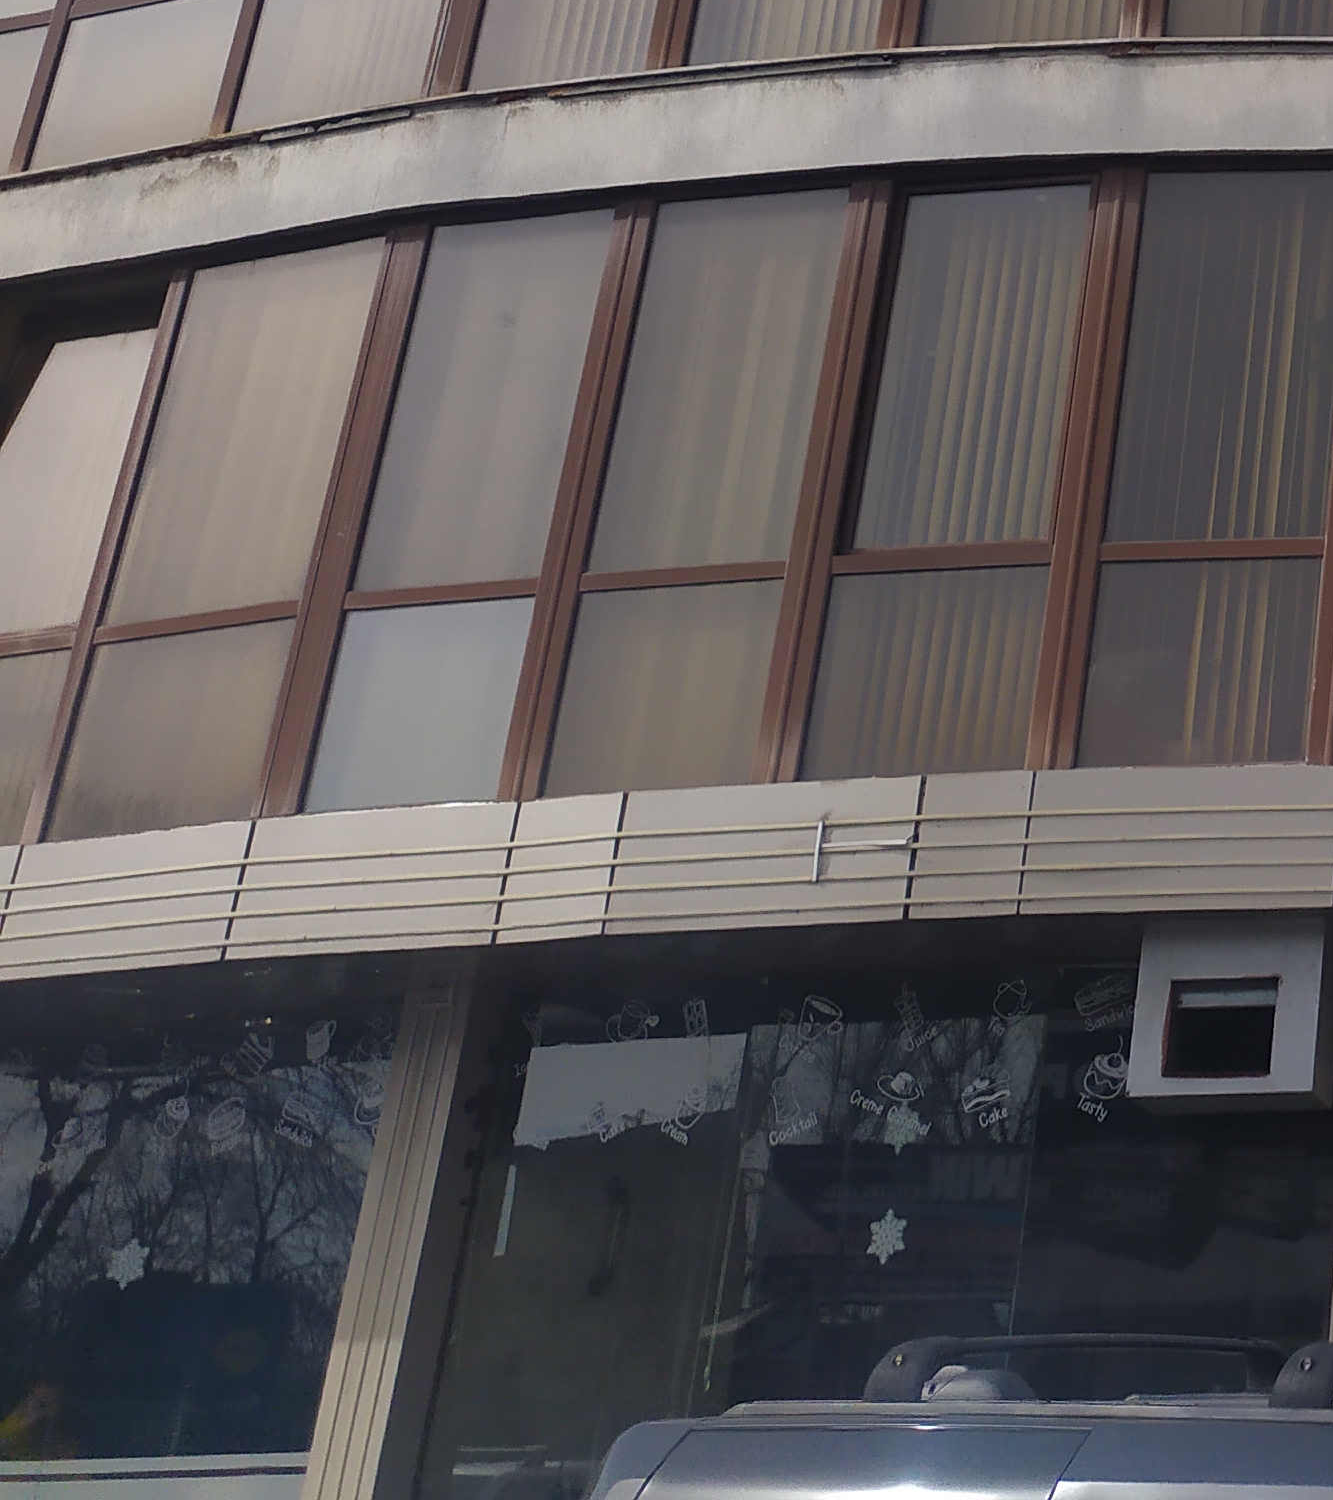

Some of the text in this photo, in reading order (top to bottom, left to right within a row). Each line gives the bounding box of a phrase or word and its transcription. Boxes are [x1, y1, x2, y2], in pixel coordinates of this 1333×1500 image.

[904, 1026, 940, 1053] Juice
[850, 1089, 885, 1115] Creme
[1076, 1091, 1109, 1123] Tasty
[661, 1115, 689, 1146] Cream
[769, 1111, 819, 1147] Cocktail
[978, 1105, 1009, 1129] Cake
